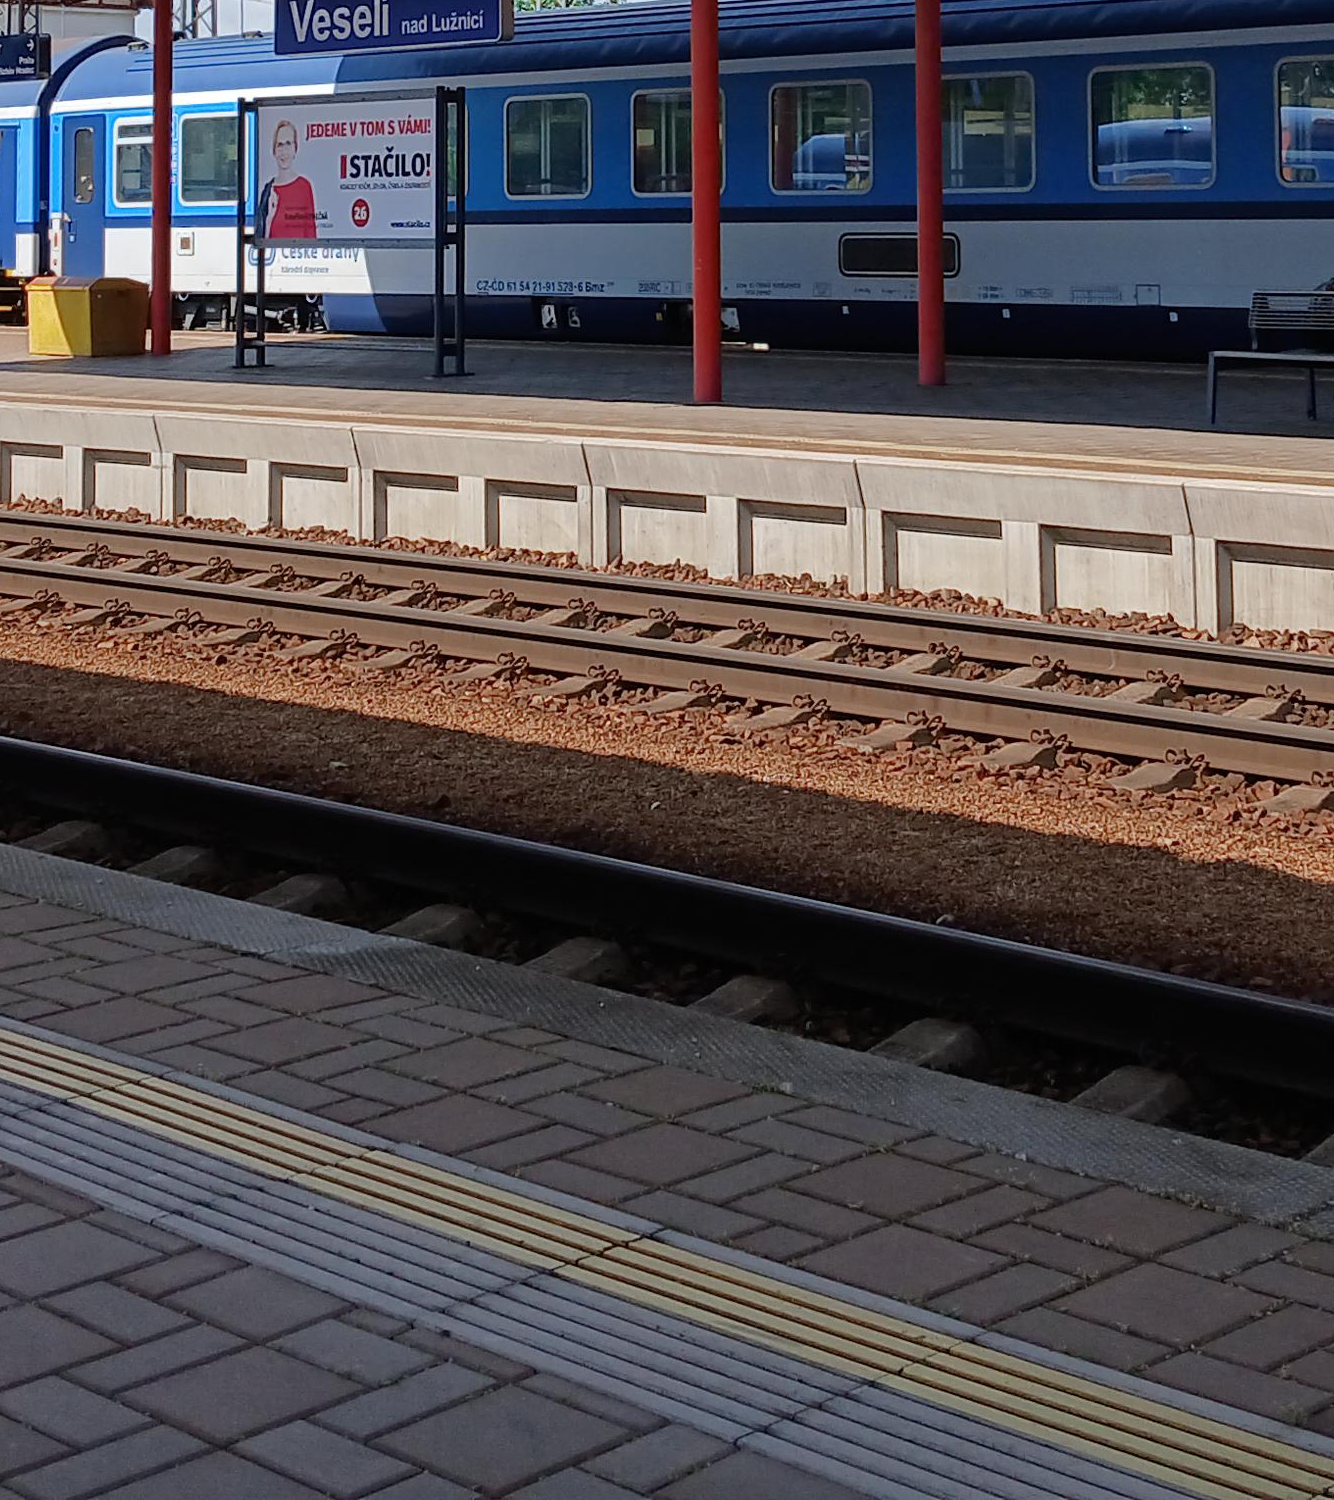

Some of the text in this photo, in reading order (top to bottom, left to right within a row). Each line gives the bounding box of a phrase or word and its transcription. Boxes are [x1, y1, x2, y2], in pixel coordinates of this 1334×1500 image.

[401, 14, 428, 35] nad
[432, 9, 484, 32] Lužnicí
[306, 114, 431, 141] JEDEME V TOM S VÁMI!
[349, 146, 431, 179] STAČILO!
[354, 206, 368, 221] 26
[476, 277, 505, 292] CZ-ČD
